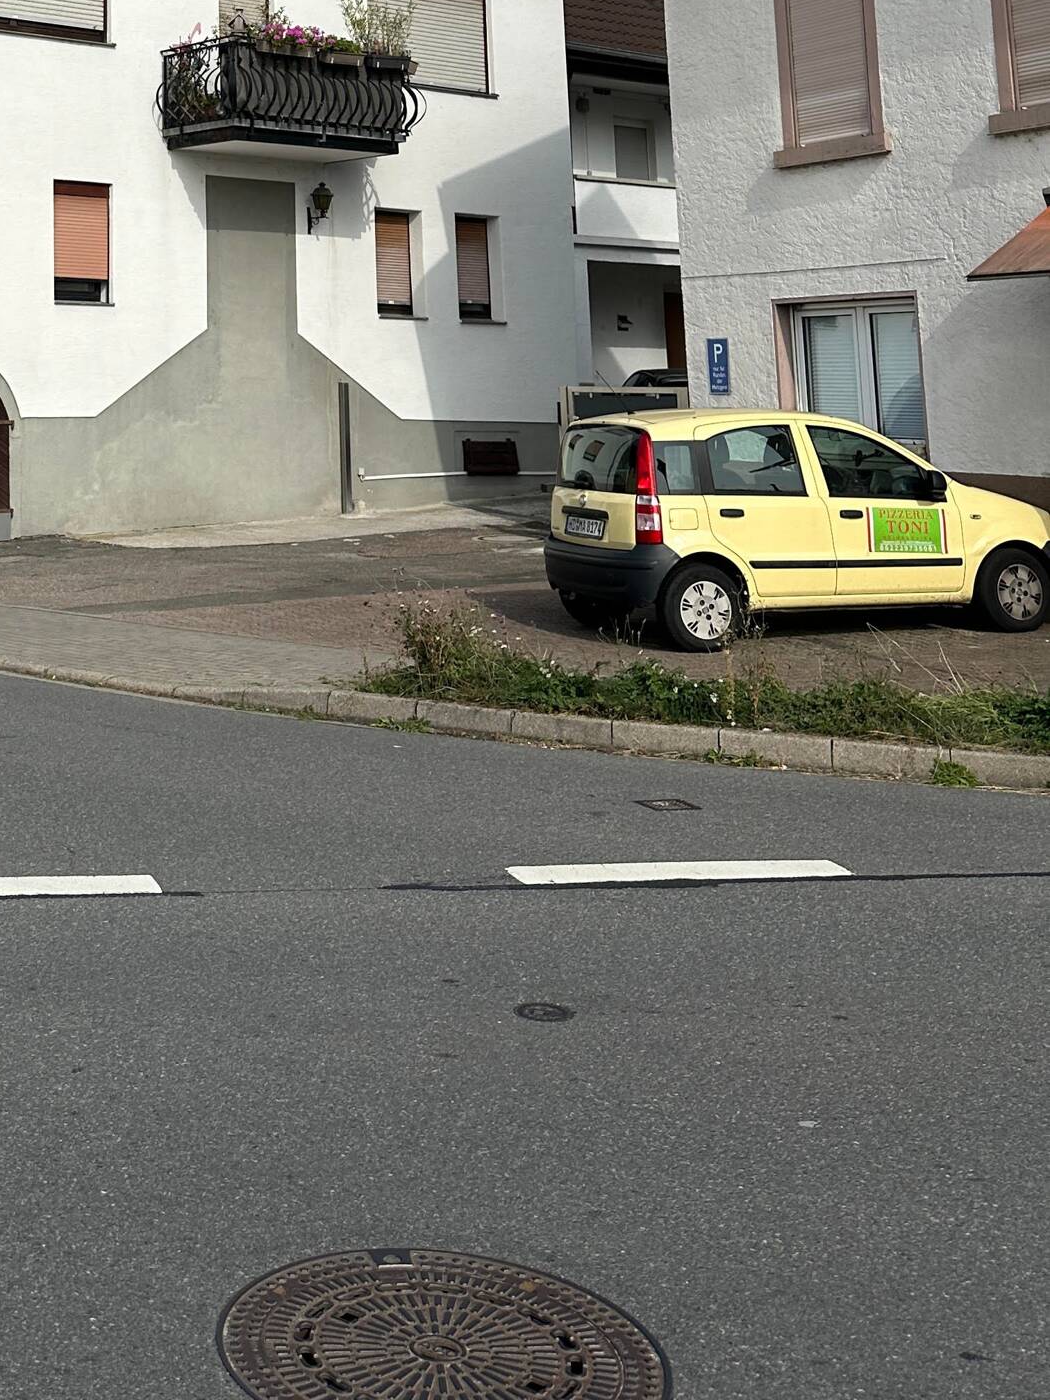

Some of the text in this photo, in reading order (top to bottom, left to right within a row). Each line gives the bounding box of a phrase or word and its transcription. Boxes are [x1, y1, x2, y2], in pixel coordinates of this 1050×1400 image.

[713, 343, 723, 363] P
[878, 509, 934, 520] PIZZERIA
[886, 519, 929, 535] TONI
